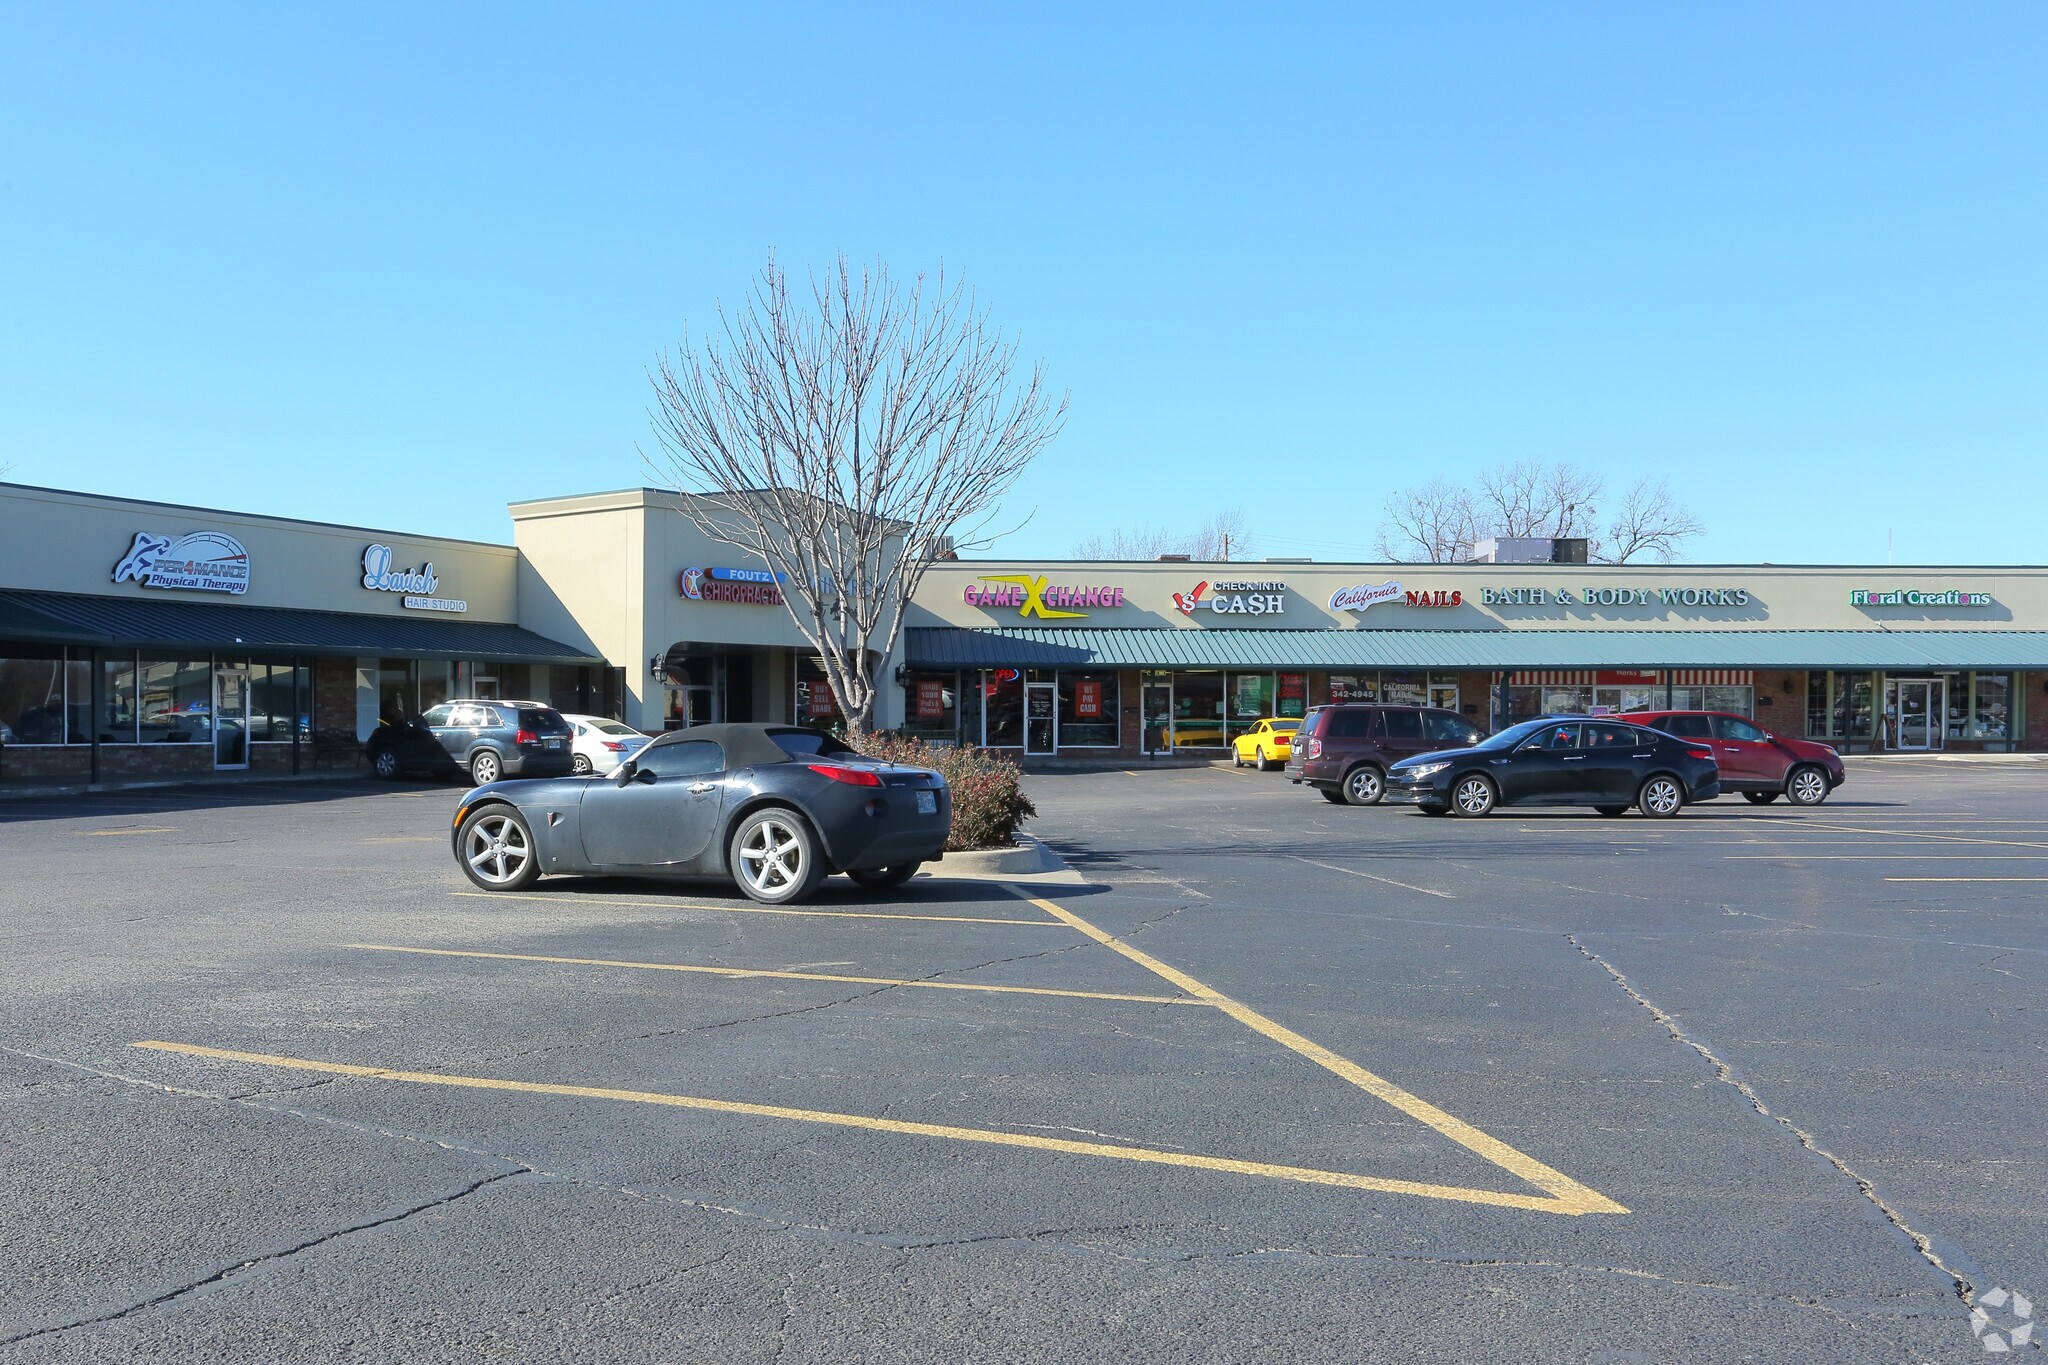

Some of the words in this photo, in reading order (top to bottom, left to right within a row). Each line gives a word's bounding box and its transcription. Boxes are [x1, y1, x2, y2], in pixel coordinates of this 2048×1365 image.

[152, 559, 247, 578] PER4MANCE
[365, 545, 438, 593] Lavish
[729, 569, 770, 582] FOUTZ
[151, 574, 198, 588] Physical
[202, 577, 248, 592] Therapy
[1212, 581, 1254, 591] CHECK
[1259, 581, 1287, 591] INTO
[963, 585, 1021, 607] GAME
[1046, 585, 1124, 608] CHANGE
[1334, 585, 1399, 608] California
[1405, 590, 1462, 607] NAILS
[1481, 587, 1546, 606] BATH
[1554, 588, 1573, 606] &
[1583, 588, 1650, 606] BODY
[1660, 588, 1749, 606] WORKS
[406, 598, 429, 609] HAIR
[432, 600, 466, 612] STUDIO
[994, 669, 1015, 679] OPEN
[1083, 685, 1093, 694] WE
[1383, 683, 1421, 691] CALIFORNIA
[814, 695, 829, 703] SELL
[921, 691, 939, 699] YOUR
[1082, 695, 1093, 703] PAY
[812, 704, 832, 713] TRADE
[1079, 704, 1096, 712] CASH
